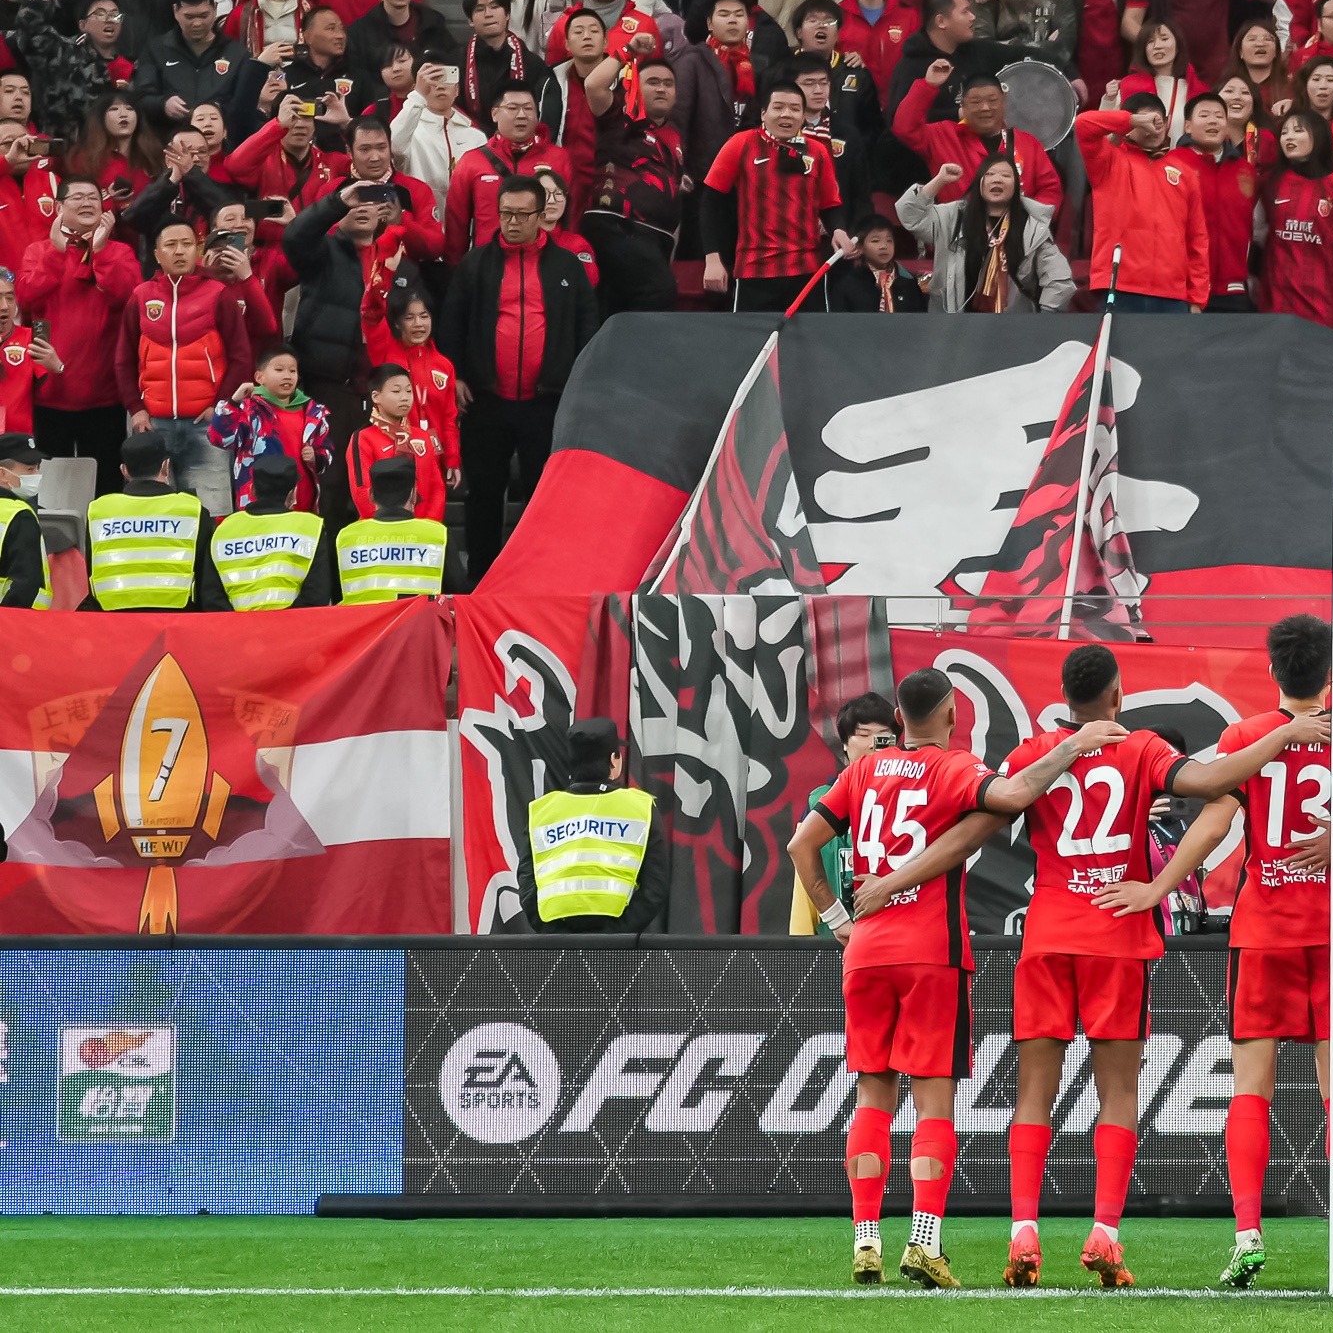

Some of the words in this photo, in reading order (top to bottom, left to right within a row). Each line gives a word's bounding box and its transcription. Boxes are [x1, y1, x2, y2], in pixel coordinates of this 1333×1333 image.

[102, 520, 182, 537] SECURITY
[224, 537, 300, 556] SECURITY
[350, 547, 428, 565] SECURITY
[148, 717, 190, 802] 7
[1045, 765, 1132, 858] 22
[1260, 761, 1331, 848] 13
[140, 840, 158, 854] HE
[162, 840, 184, 854] WU
[546, 818, 630, 846] SECURITY
[857, 788, 929, 874] 45
[463, 1050, 537, 1088] EA
[560, 1033, 766, 1133] FC
[460, 1091, 542, 1110] SPORTS
